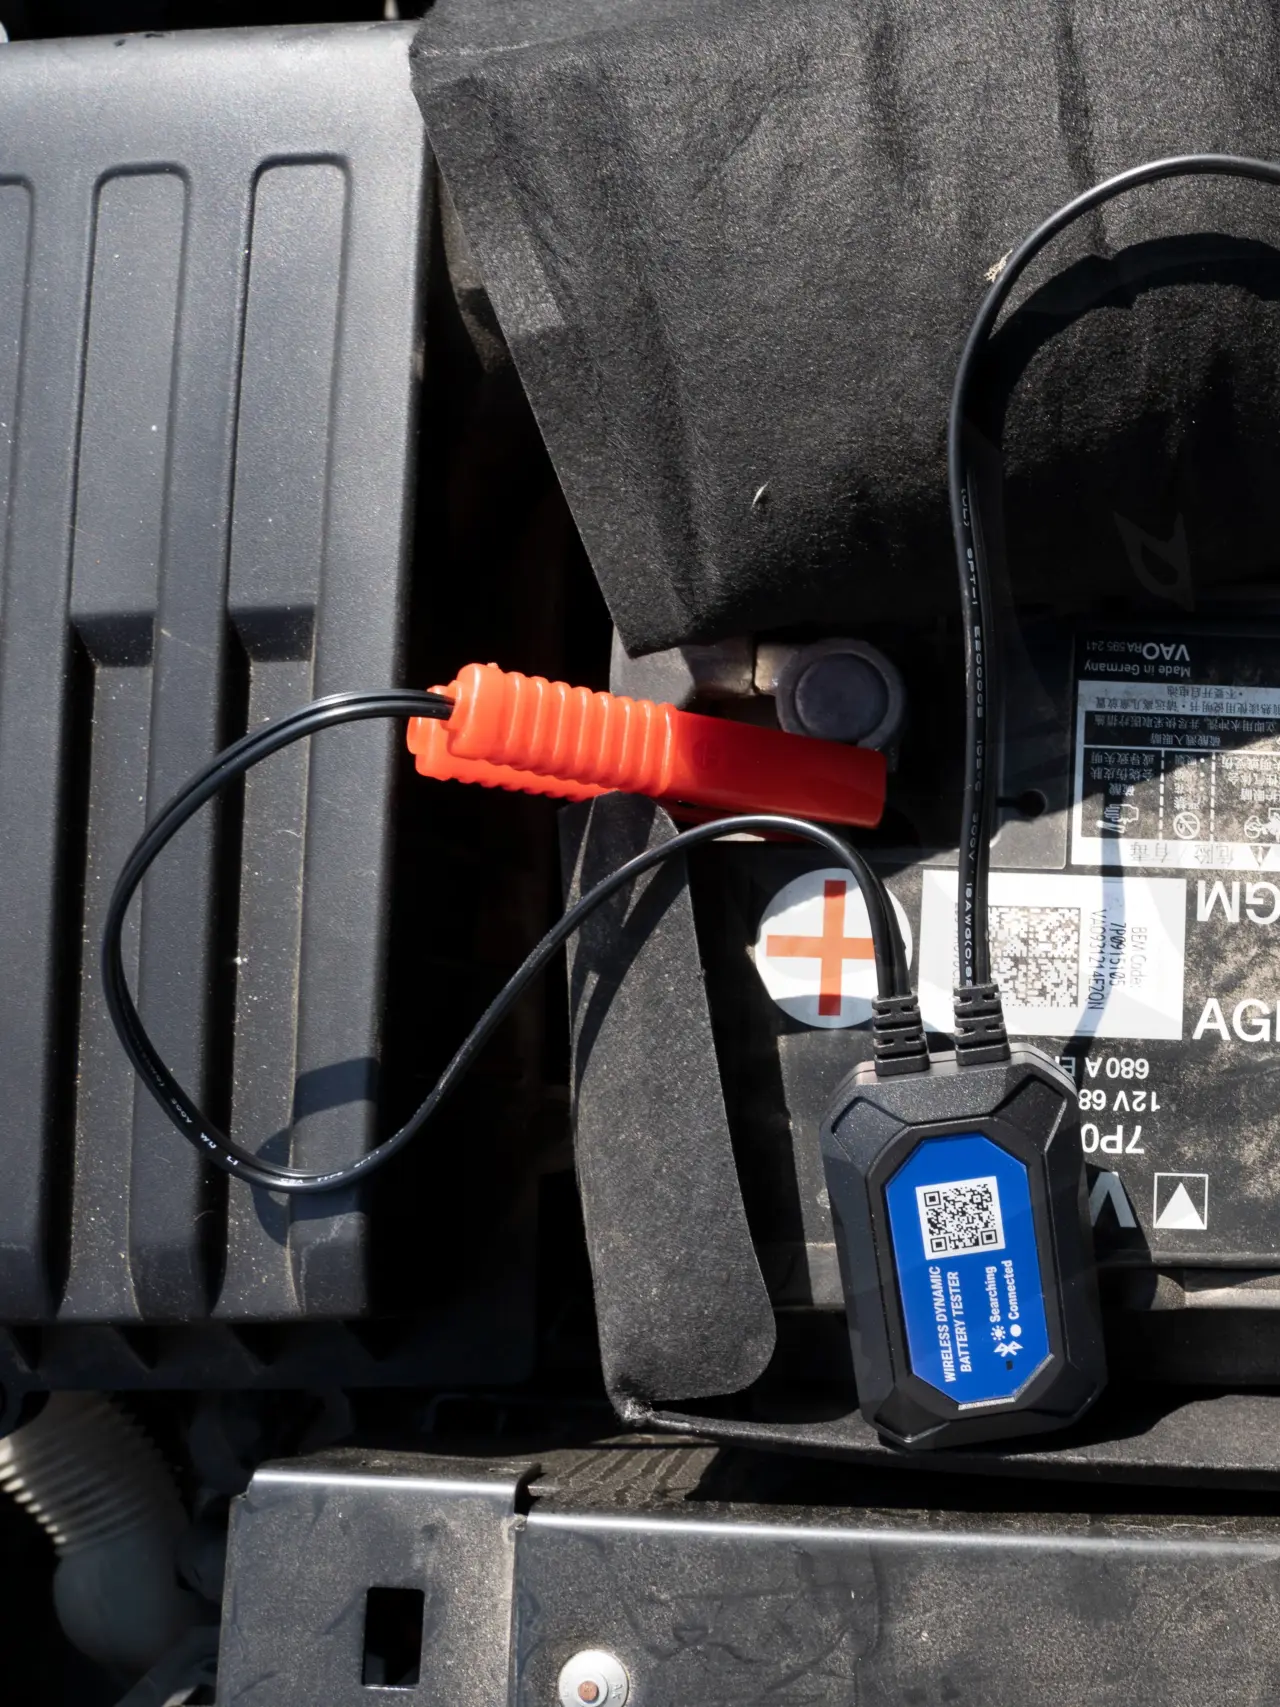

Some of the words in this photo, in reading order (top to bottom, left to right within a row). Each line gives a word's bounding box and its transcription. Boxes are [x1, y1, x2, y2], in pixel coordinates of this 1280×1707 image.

[1086, 640, 1104, 651] 241
[1084, 660, 1139, 676] Germany
[1143, 664, 1154, 677] in
[1158, 665, 1190, 678] Made
[1084, 1057, 1102, 1078] A
[1107, 1057, 1149, 1078] 680
[1079, 1090, 1106, 1111] 68
[1113, 1090, 1161, 1112] 12V
[1081, 1123, 1145, 1154] 7P0
[928, 1266, 948, 1322] DYNAMIC
[946, 1271, 964, 1316] TESTER
[984, 1266, 1001, 1323] Searching
[1002, 1259, 1020, 1320] Connected
[937, 1324, 957, 1382] WIRELESS
[953, 1318, 972, 1372] BATTERY
